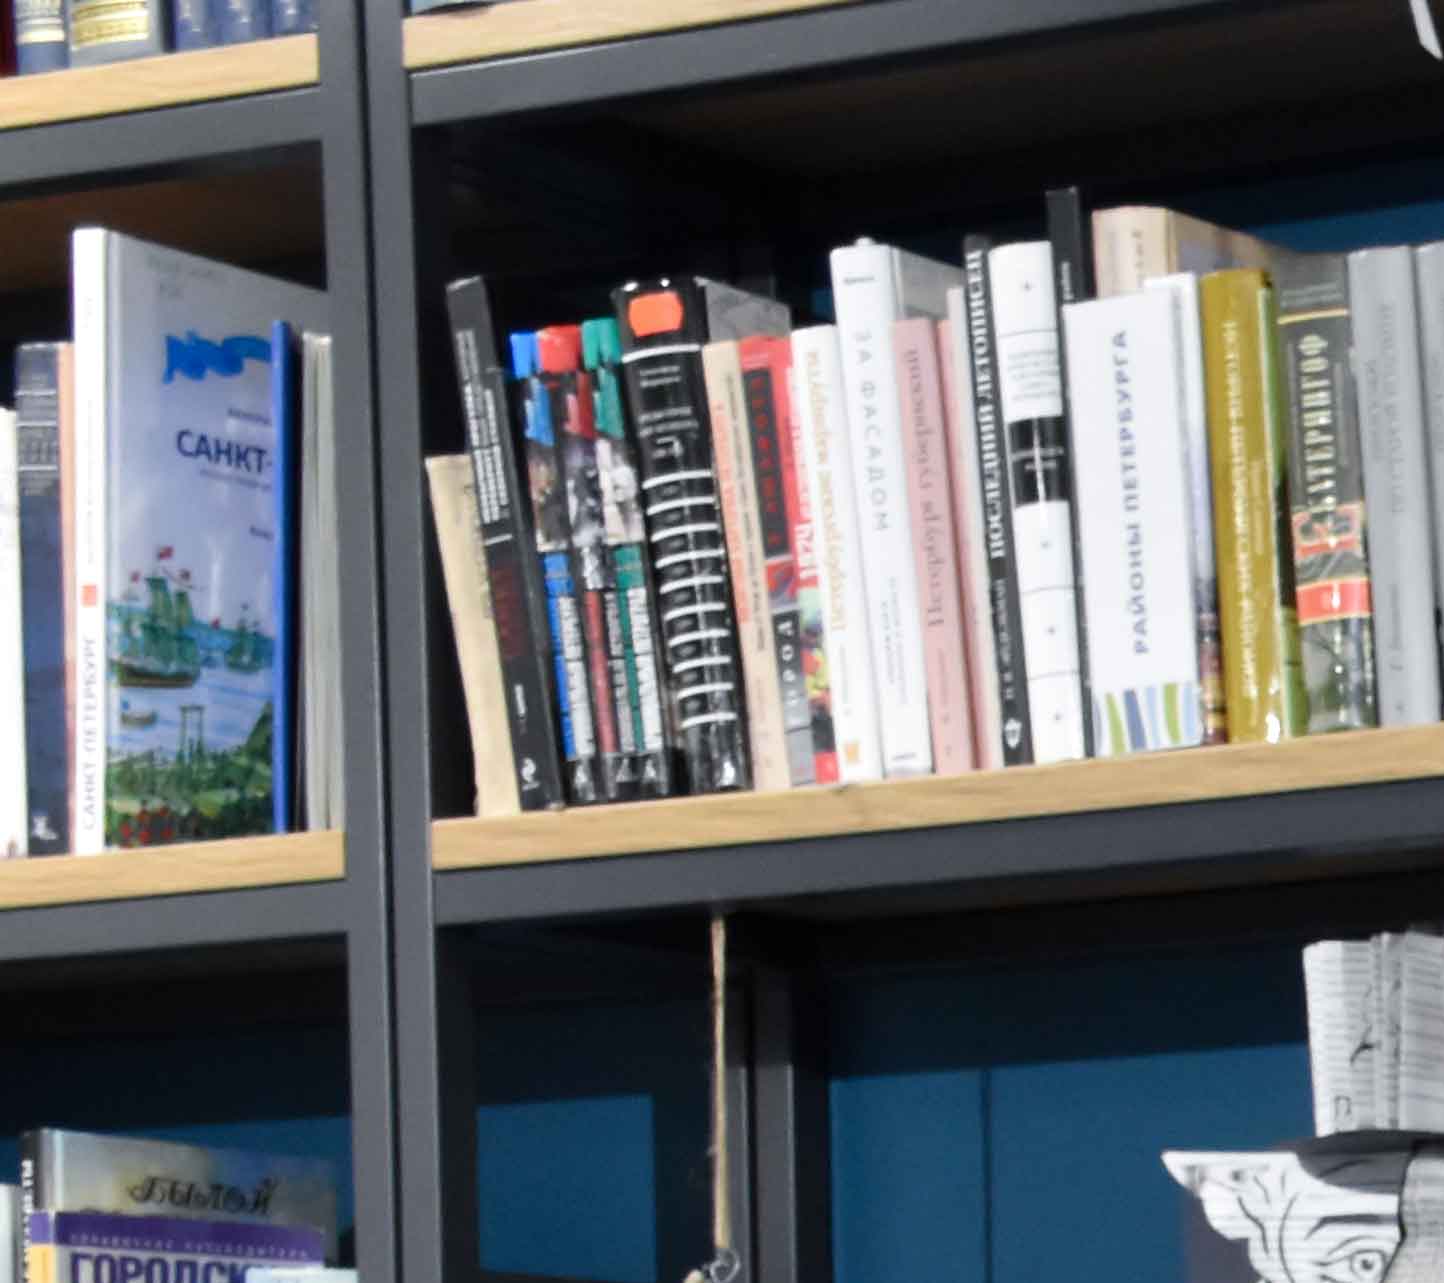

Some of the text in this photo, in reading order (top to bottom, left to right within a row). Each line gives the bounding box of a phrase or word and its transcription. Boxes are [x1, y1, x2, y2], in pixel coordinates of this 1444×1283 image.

[966, 251, 990, 398] ЛЕТОПИСЕЦ
[977, 406, 1006, 558] ПОСЛЕДНИЙ
[1111, 330, 1149, 655] РАЙОНЫ ПЕТЕРБУРГА
